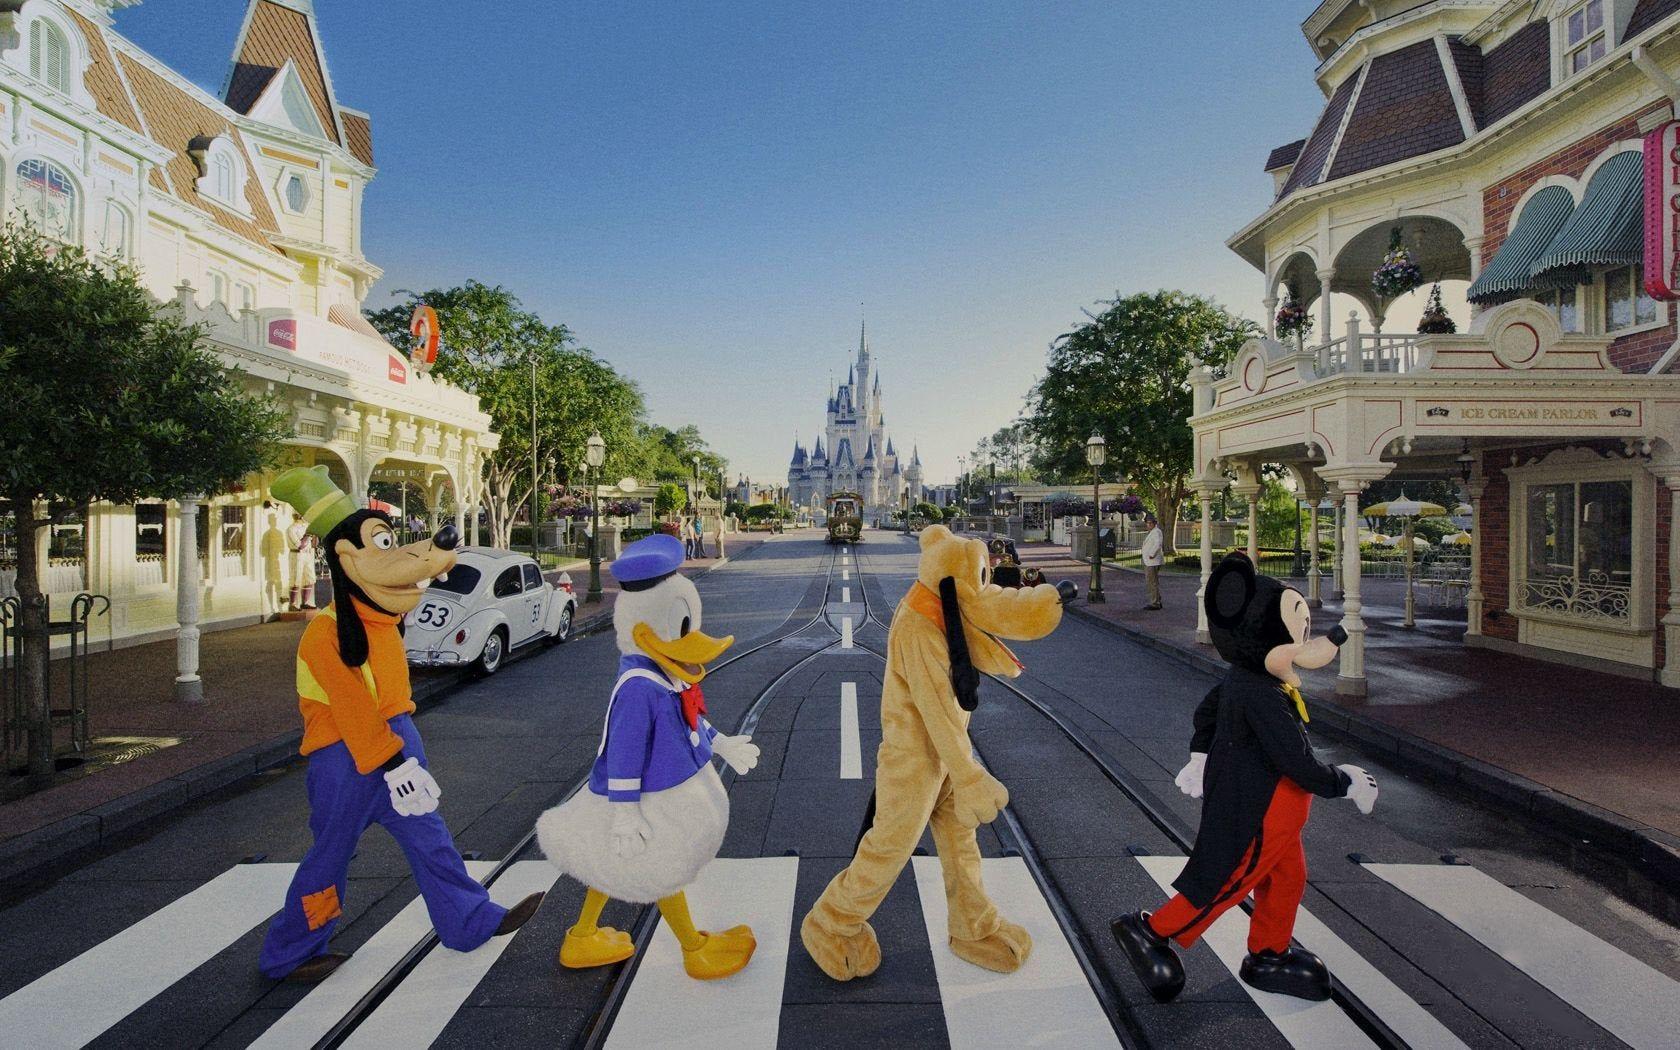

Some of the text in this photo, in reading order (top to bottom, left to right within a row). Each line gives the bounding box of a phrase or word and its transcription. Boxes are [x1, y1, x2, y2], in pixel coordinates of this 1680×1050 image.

[1461, 408, 1485, 419] ICE
[1487, 408, 1539, 419] CREAM
[1542, 408, 1598, 420] PARLOR
[418, 603, 450, 628] 53
[532, 604, 541, 623] 53
